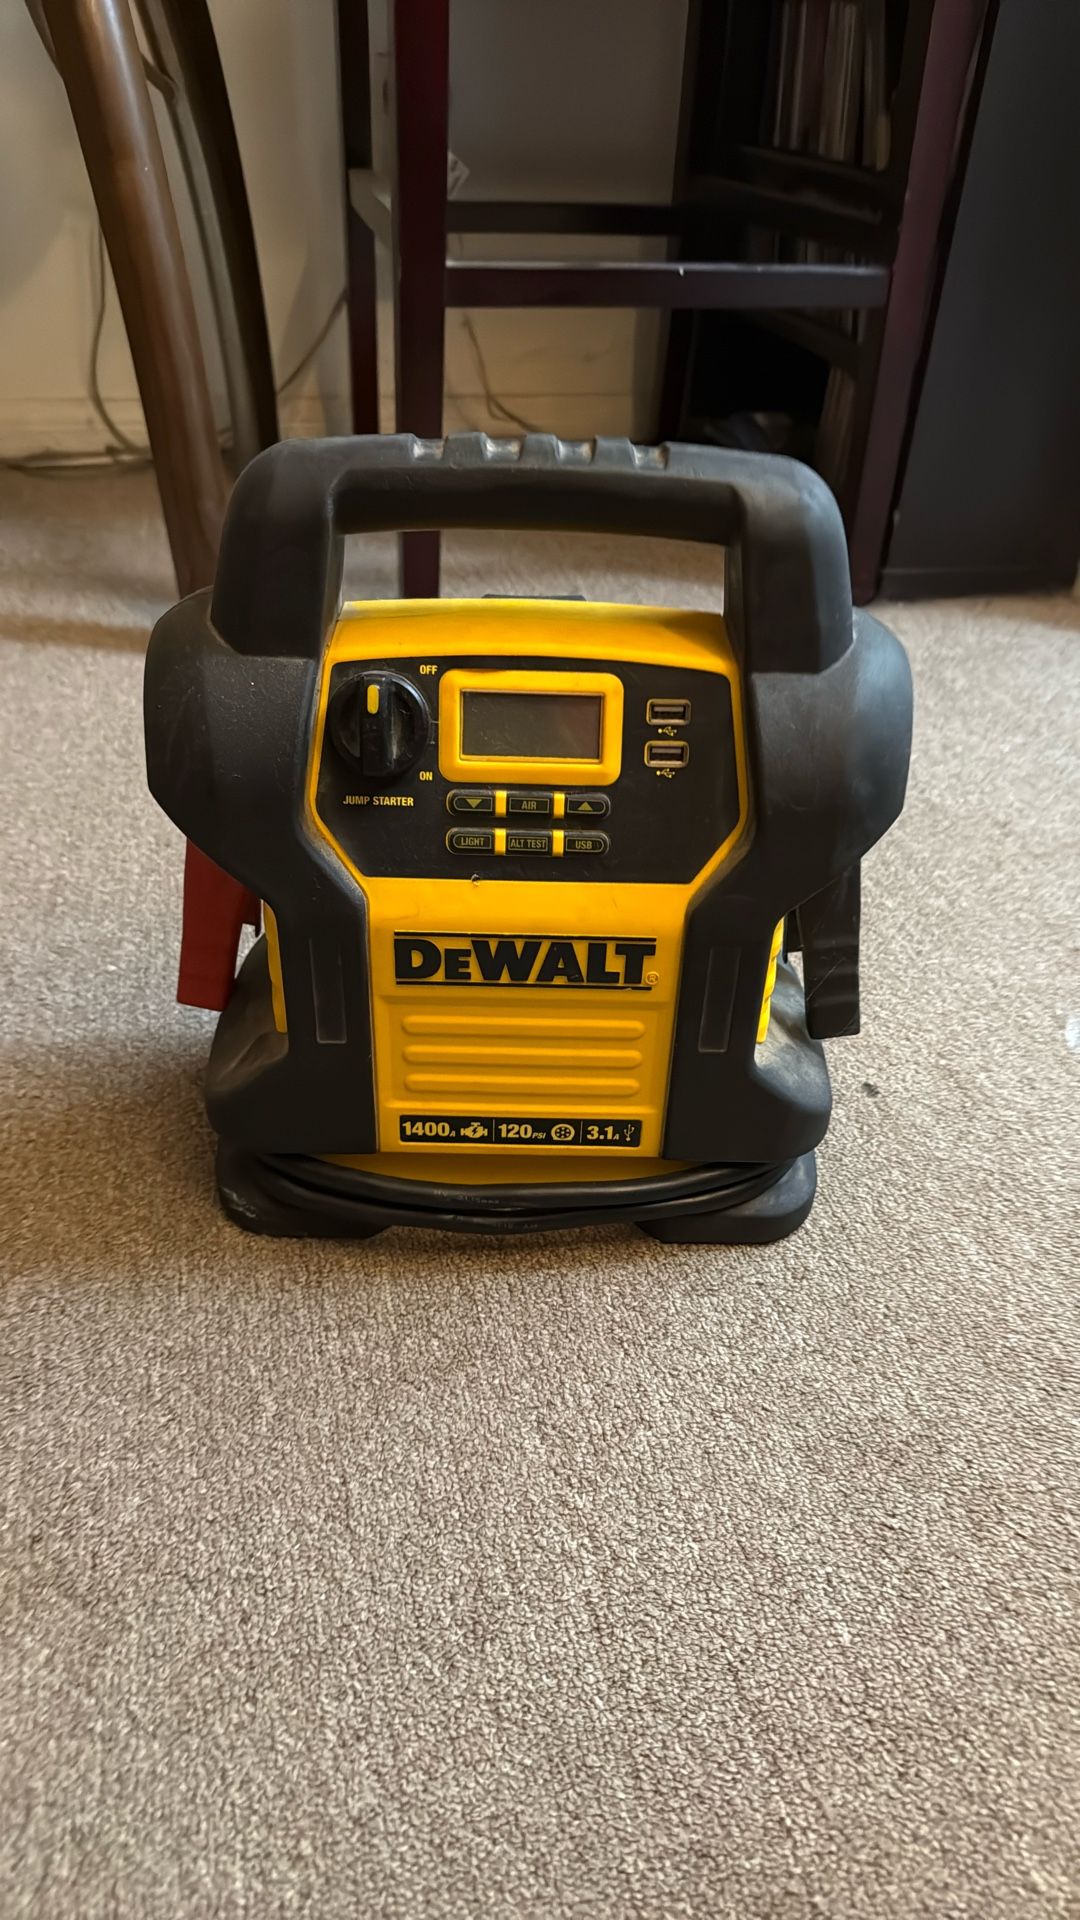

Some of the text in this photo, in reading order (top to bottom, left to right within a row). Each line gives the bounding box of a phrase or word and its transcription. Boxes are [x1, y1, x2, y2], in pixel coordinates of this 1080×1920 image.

[419, 664, 438, 675] OFF
[419, 770, 433, 781] ON
[342, 795, 414, 807] JUMP STARTER
[521, 800, 537, 810] AIR
[460, 837, 485, 847] LIGHT
[510, 839, 546, 849] ALT TEST
[575, 841, 593, 850] USB
